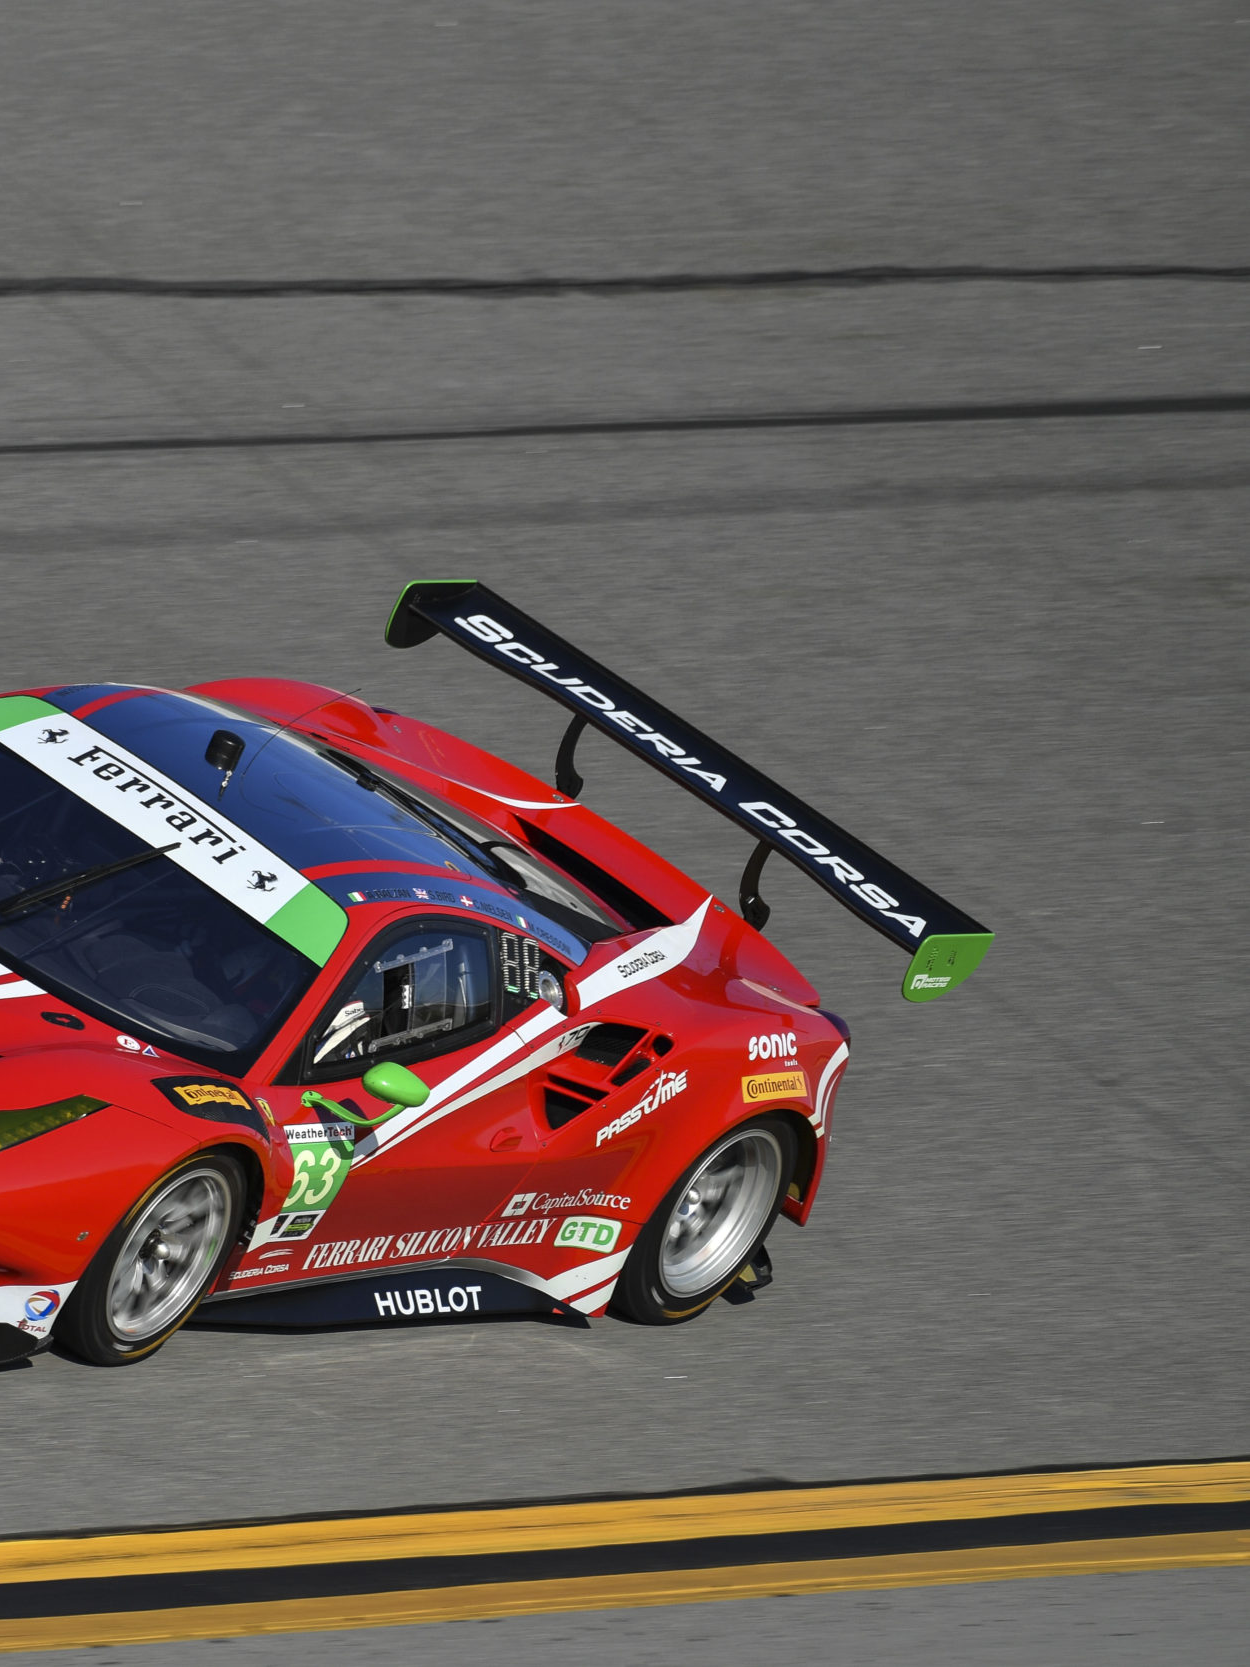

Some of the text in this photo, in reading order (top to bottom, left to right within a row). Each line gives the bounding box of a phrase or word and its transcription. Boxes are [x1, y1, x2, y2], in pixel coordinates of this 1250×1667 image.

[454, 614, 928, 938] SCUDERIA CORSA
[67, 745, 247, 866] Ferrari
[748, 1032, 798, 1061] SONIC
[746, 1074, 797, 1099] Continental
[285, 1125, 353, 1140] WeatherTech
[283, 1147, 342, 1208] 63
[532, 1189, 632, 1214] CapitalSource
[302, 1218, 558, 1271] FERRARI SILICON VALLEY
[559, 1221, 616, 1246] GTD
[264, 1263, 290, 1275] CORSA
[374, 1286, 482, 1316] HUBLOT
